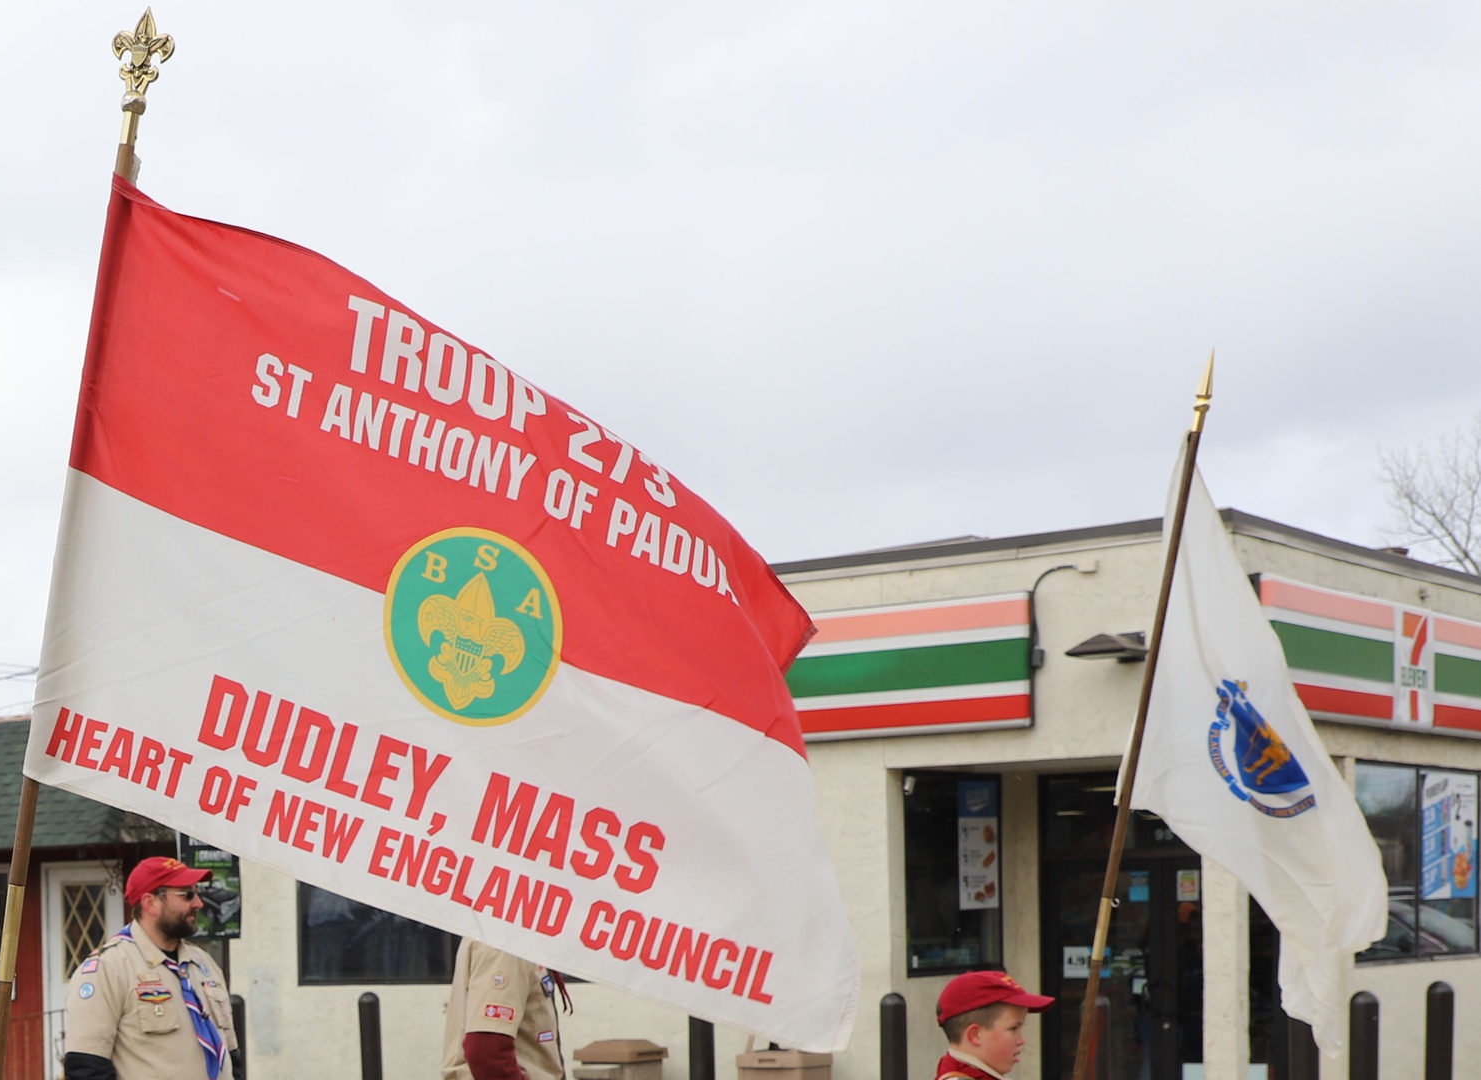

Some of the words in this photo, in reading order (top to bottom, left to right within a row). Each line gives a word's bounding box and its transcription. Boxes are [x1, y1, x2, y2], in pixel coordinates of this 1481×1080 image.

[251, 353, 313, 419] ST
[320, 382, 537, 501] ANTHONY
[543, 468, 599, 531] OF
[606, 496, 741, 607] PADUA
[347, 294, 547, 433] TROOP
[566, 411, 677, 508] 273
[45, 706, 194, 799] HEART
[198, 765, 258, 823] OF
[262, 788, 364, 864] NEW
[367, 826, 574, 938] ENGLAND
[579, 900, 775, 1005] COUNCIL
[198, 674, 452, 836] DUDLEY,
[471, 772, 666, 894] MASS
